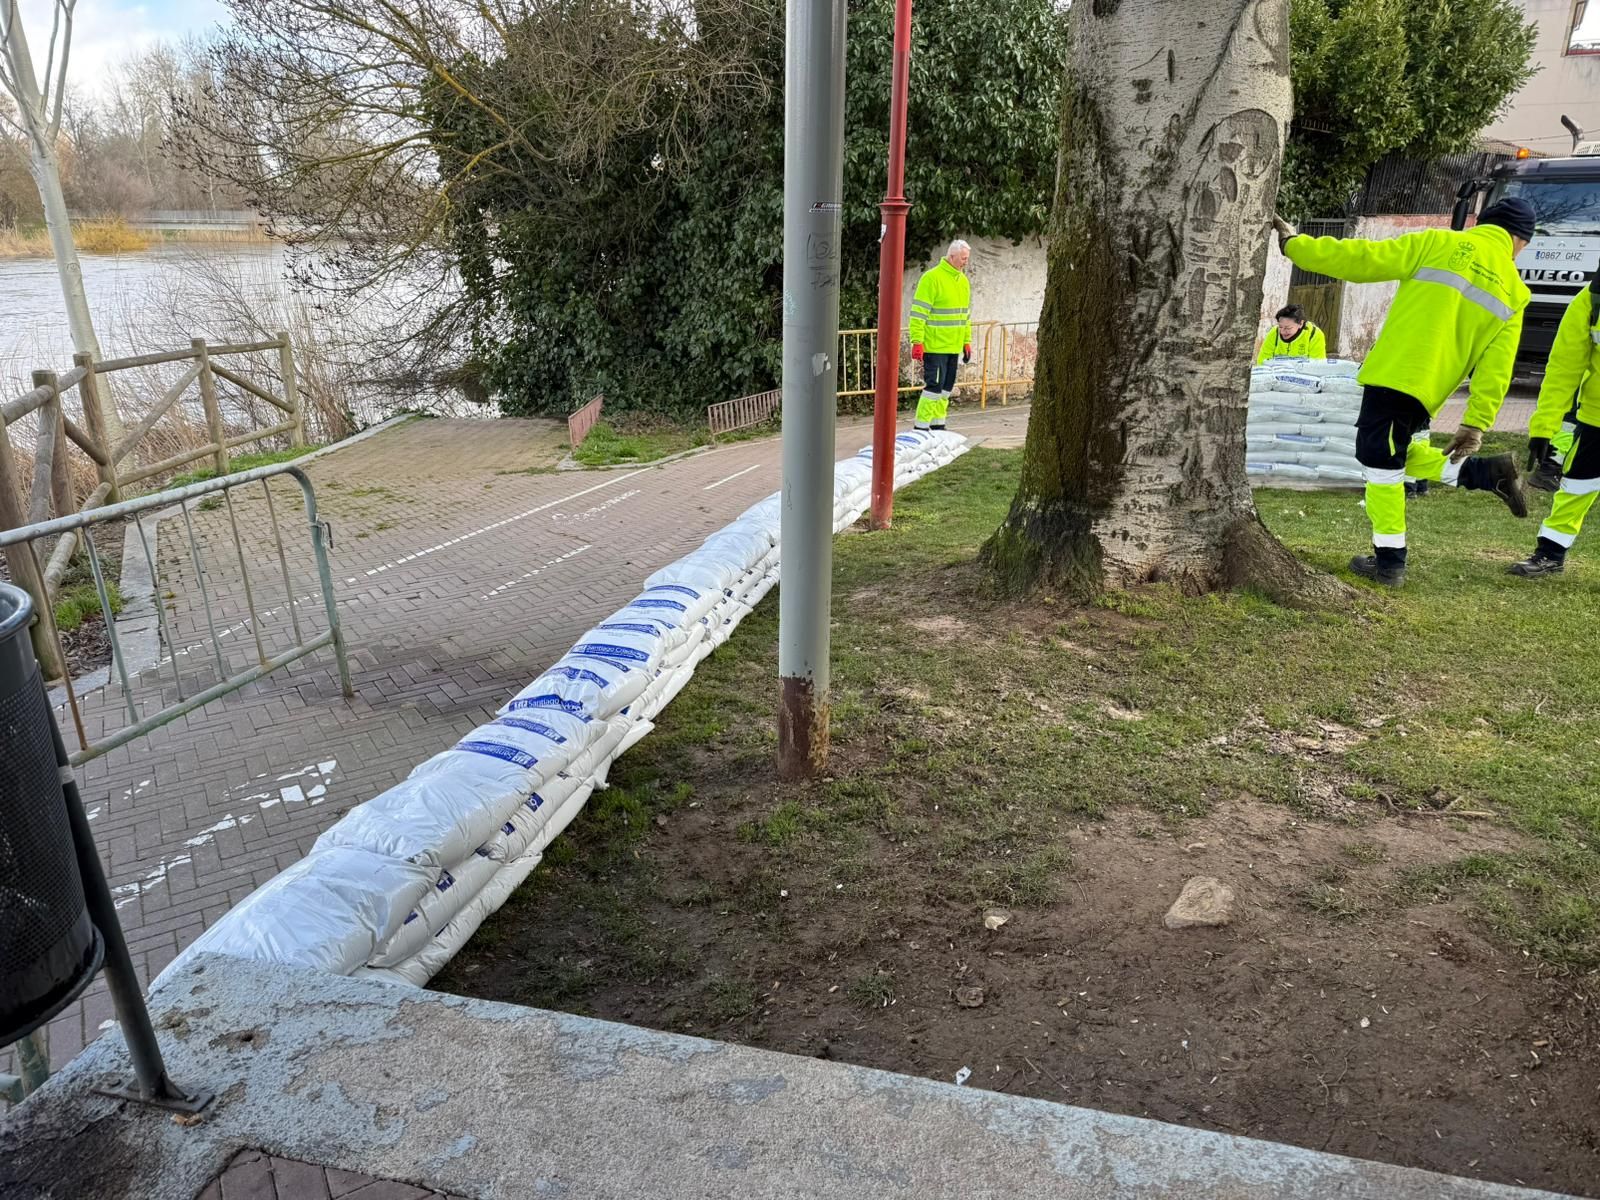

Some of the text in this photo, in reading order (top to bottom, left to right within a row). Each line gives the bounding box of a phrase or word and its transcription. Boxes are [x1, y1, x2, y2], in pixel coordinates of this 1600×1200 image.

[1539, 251, 1583, 261] 0867 GHZ
[1520, 269, 1585, 283] IVECO
[586, 643, 616, 653] Santiago
